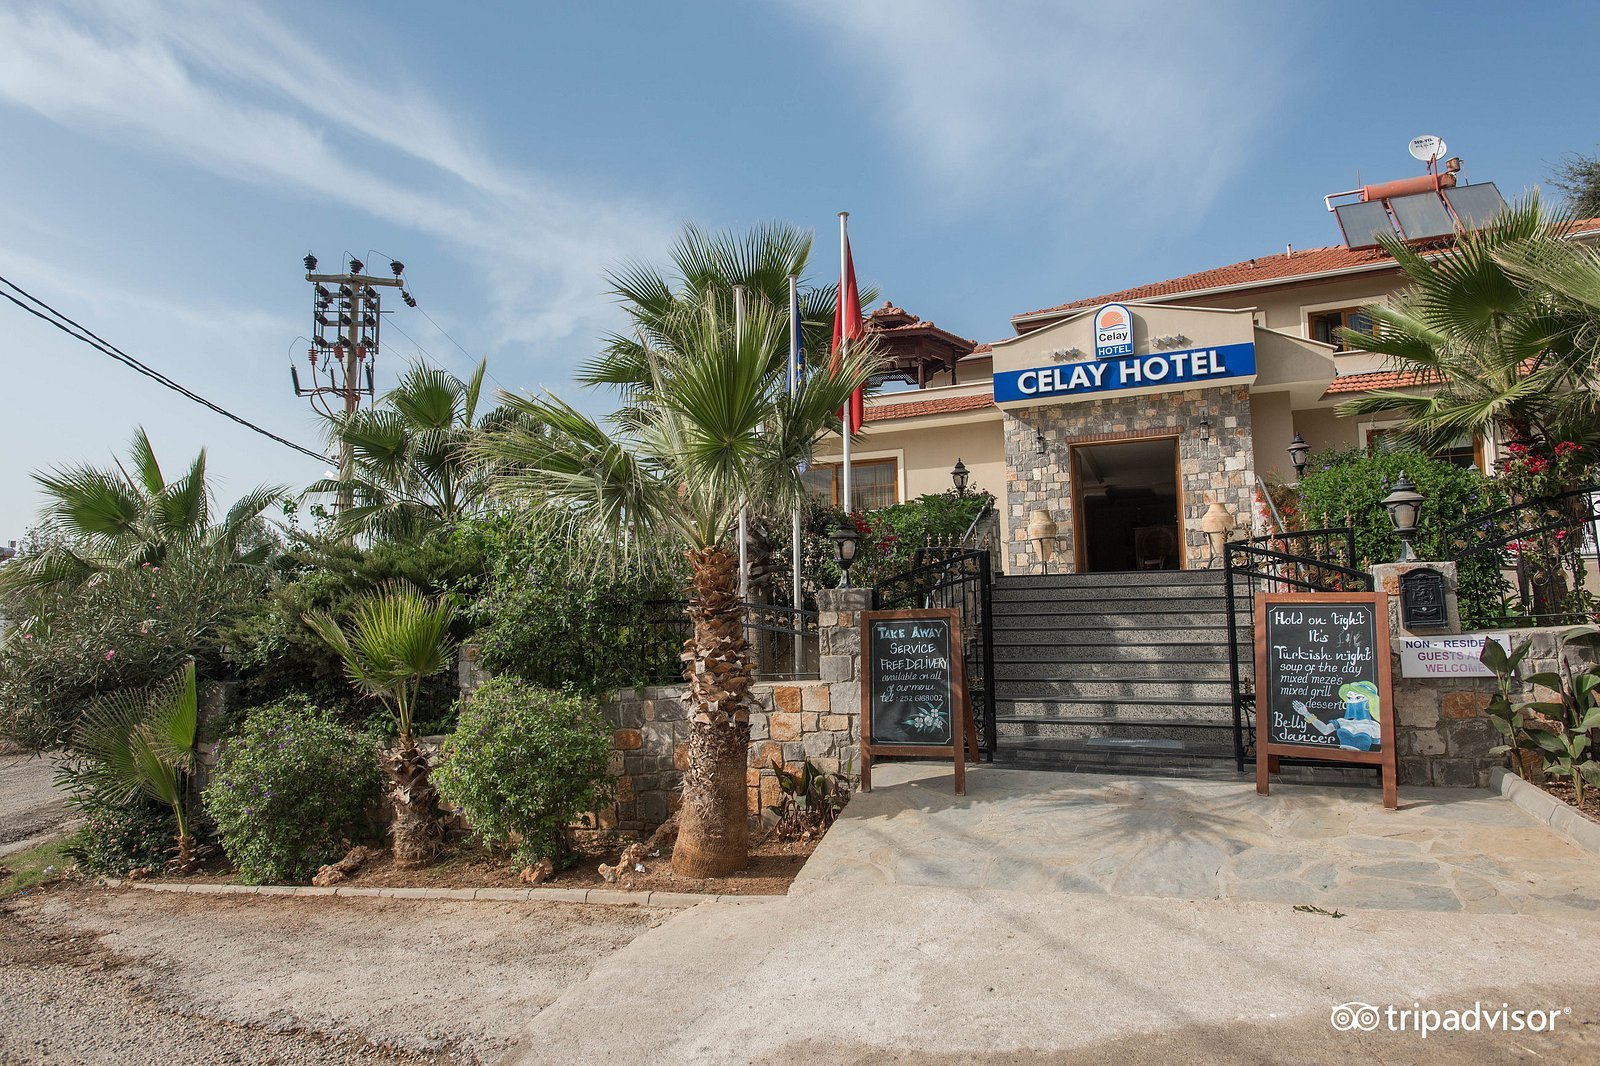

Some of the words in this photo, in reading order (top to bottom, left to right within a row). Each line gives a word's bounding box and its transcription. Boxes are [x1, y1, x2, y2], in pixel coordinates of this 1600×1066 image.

[1098, 331, 1128, 342] Celay
[1098, 344, 1131, 356] HOTEL
[1017, 362, 1108, 395] CELAY
[1119, 350, 1226, 384] HOTEL
[1275, 612, 1303, 625] Hold
[1308, 616, 1326, 625] on
[878, 626, 905, 640] TAKE
[911, 626, 943, 638] AWAY
[1308, 630, 1328, 642] It's
[1405, 640, 1430, 648] NON
[1274, 646, 1333, 660] Turkish
[1418, 651, 1464, 660] GUESTS
[880, 658, 905, 670] FREE
[1280, 664, 1302, 673] soup
[1304, 664, 1316, 674] of
[1318, 662, 1338, 673] the
[1342, 662, 1362, 676] day
[1426, 664, 1486, 672] WELCOME
[882, 672, 917, 681] available
[930, 670, 942, 680] all
[1280, 673, 1308, 684] mixed
[1280, 684, 1308, 696] mixed
[1310, 686, 1332, 700] grill
[1274, 712, 1307, 732] Belly
[1280, 728, 1336, 744] dancer
